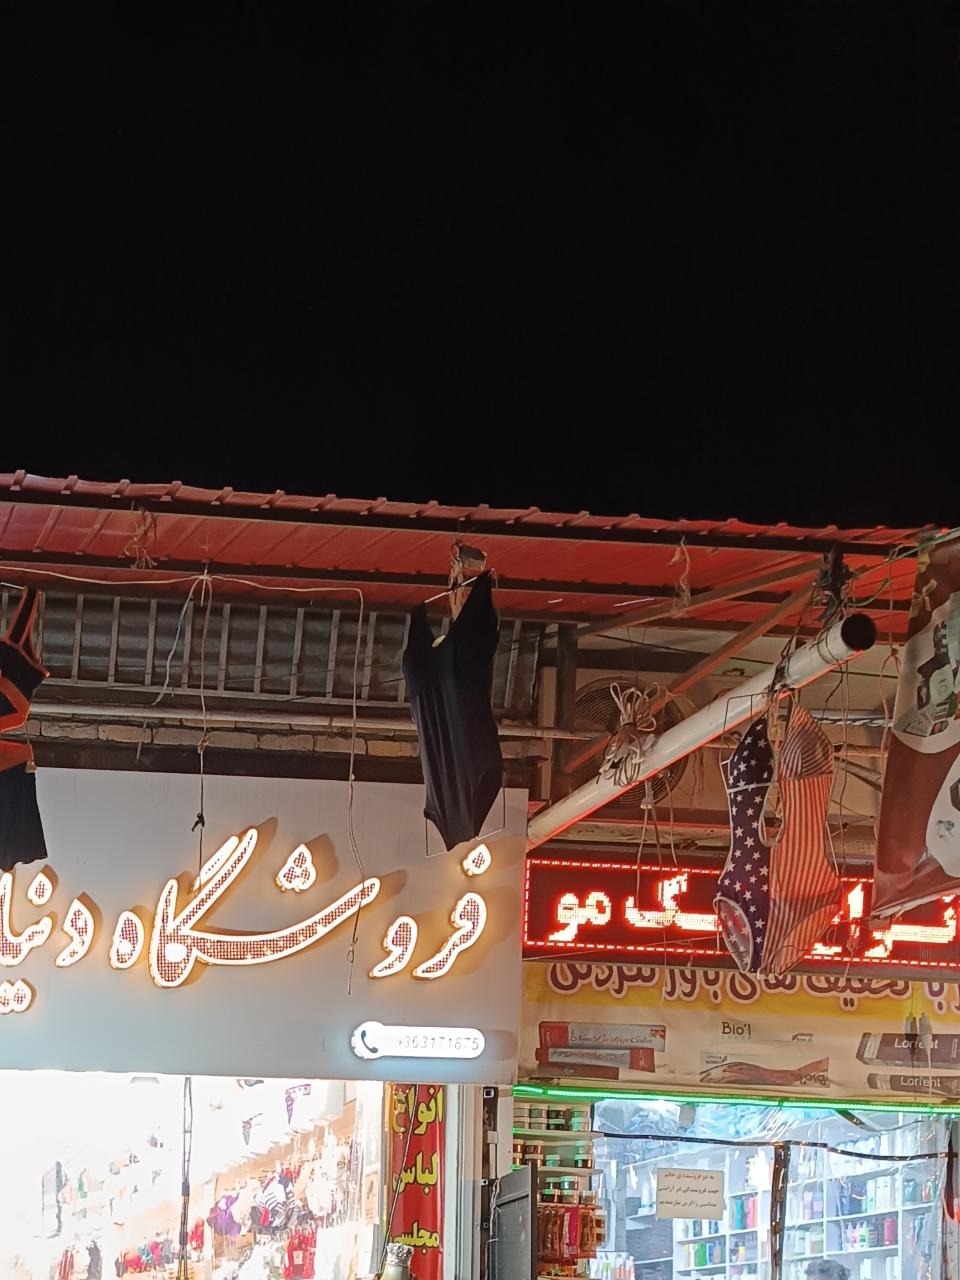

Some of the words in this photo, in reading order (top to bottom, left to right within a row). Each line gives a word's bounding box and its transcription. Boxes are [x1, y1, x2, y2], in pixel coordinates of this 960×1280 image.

[109, 828, 492, 989] فروشگاه
[894, 1036, 940, 1049] Loriet
[392, 1086, 444, 1135] انواع
[393, 1151, 439, 1195] لباس
